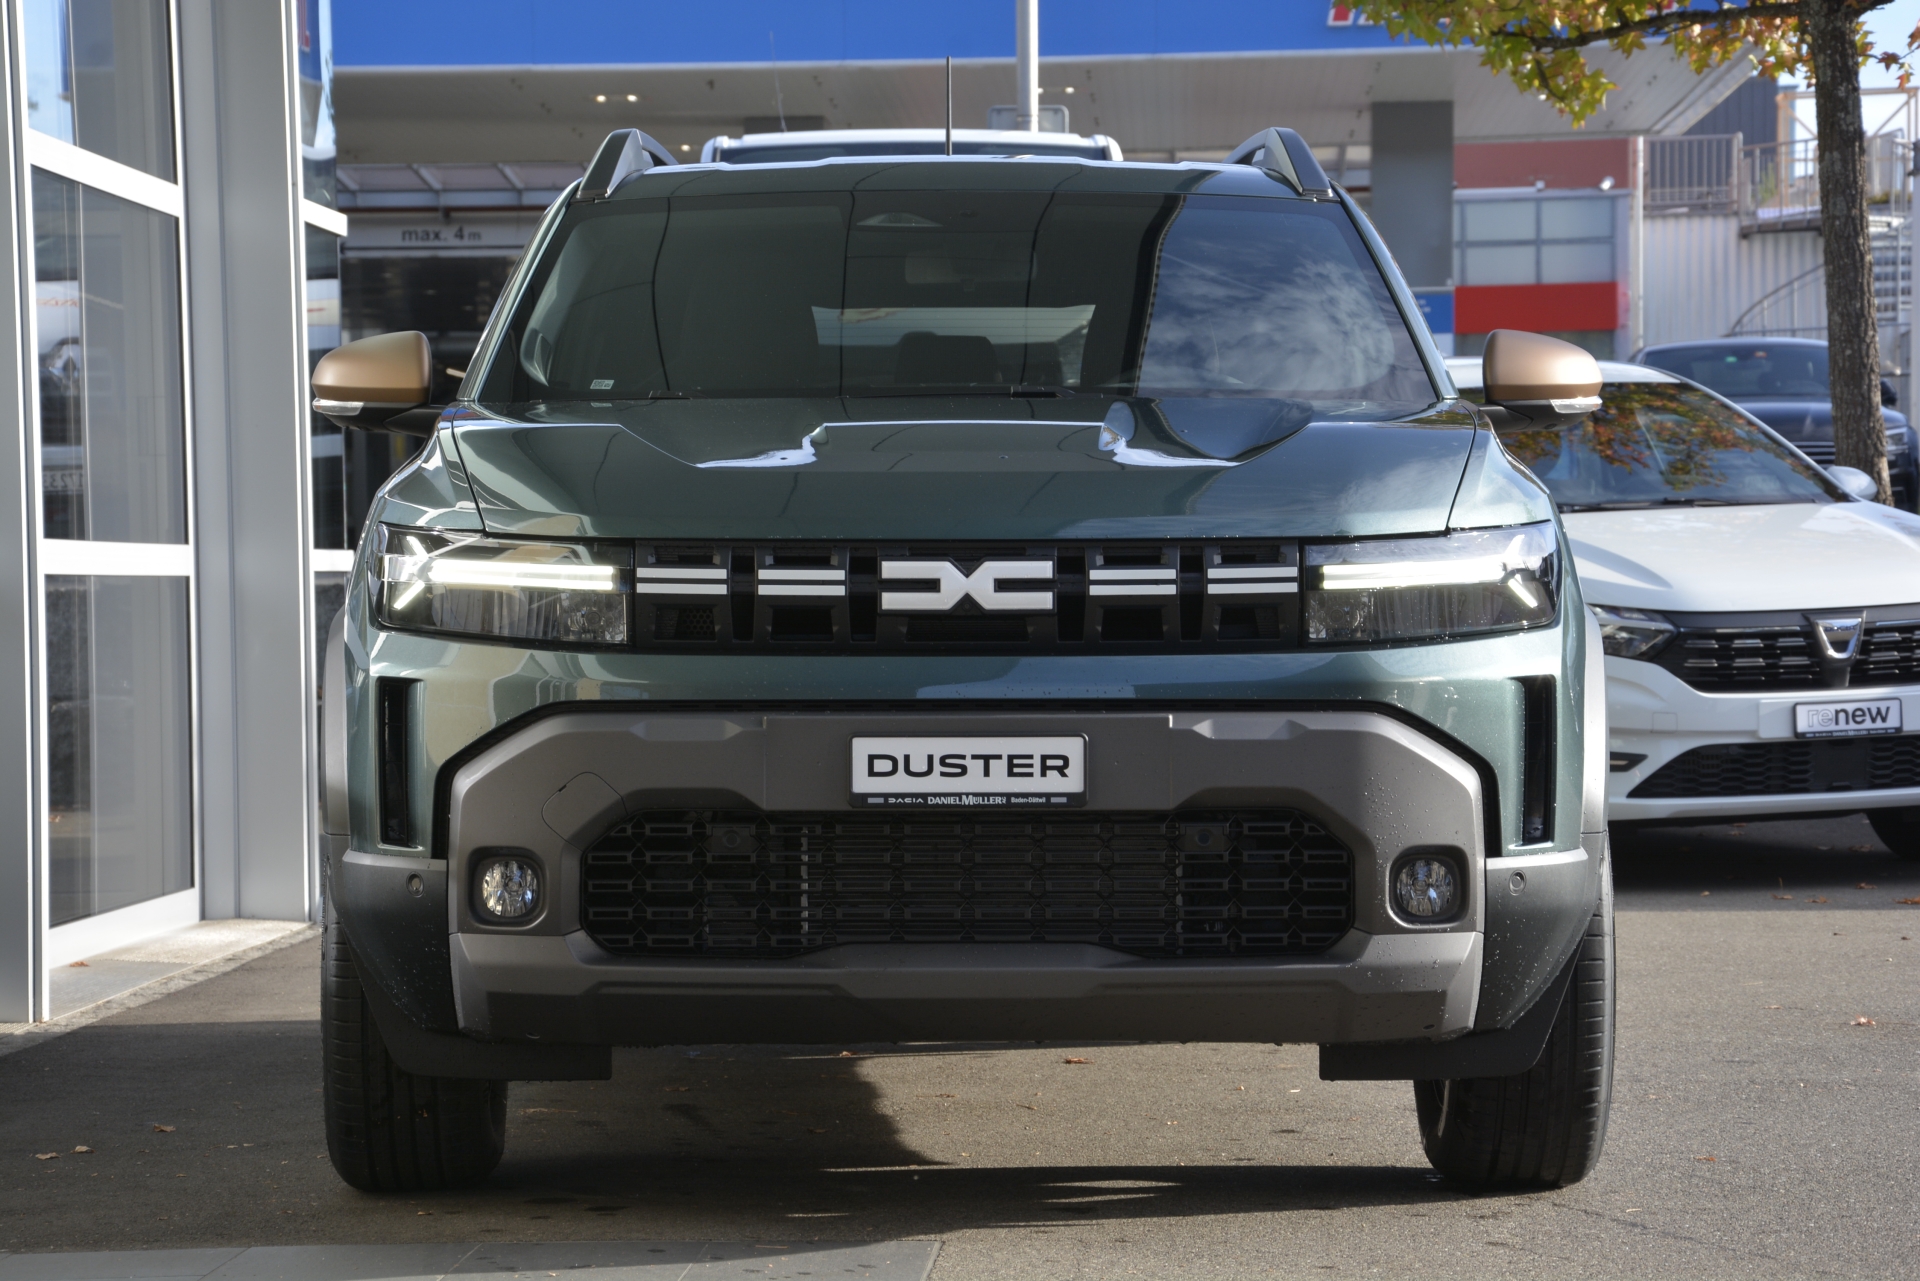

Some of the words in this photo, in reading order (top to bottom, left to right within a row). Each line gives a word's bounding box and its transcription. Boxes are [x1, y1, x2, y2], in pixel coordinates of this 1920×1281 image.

[401, 228, 447, 242] max.
[454, 226, 465, 241] 4
[467, 231, 481, 241] m
[1807, 706, 1891, 728] renew
[867, 754, 1070, 778] DUSTER
